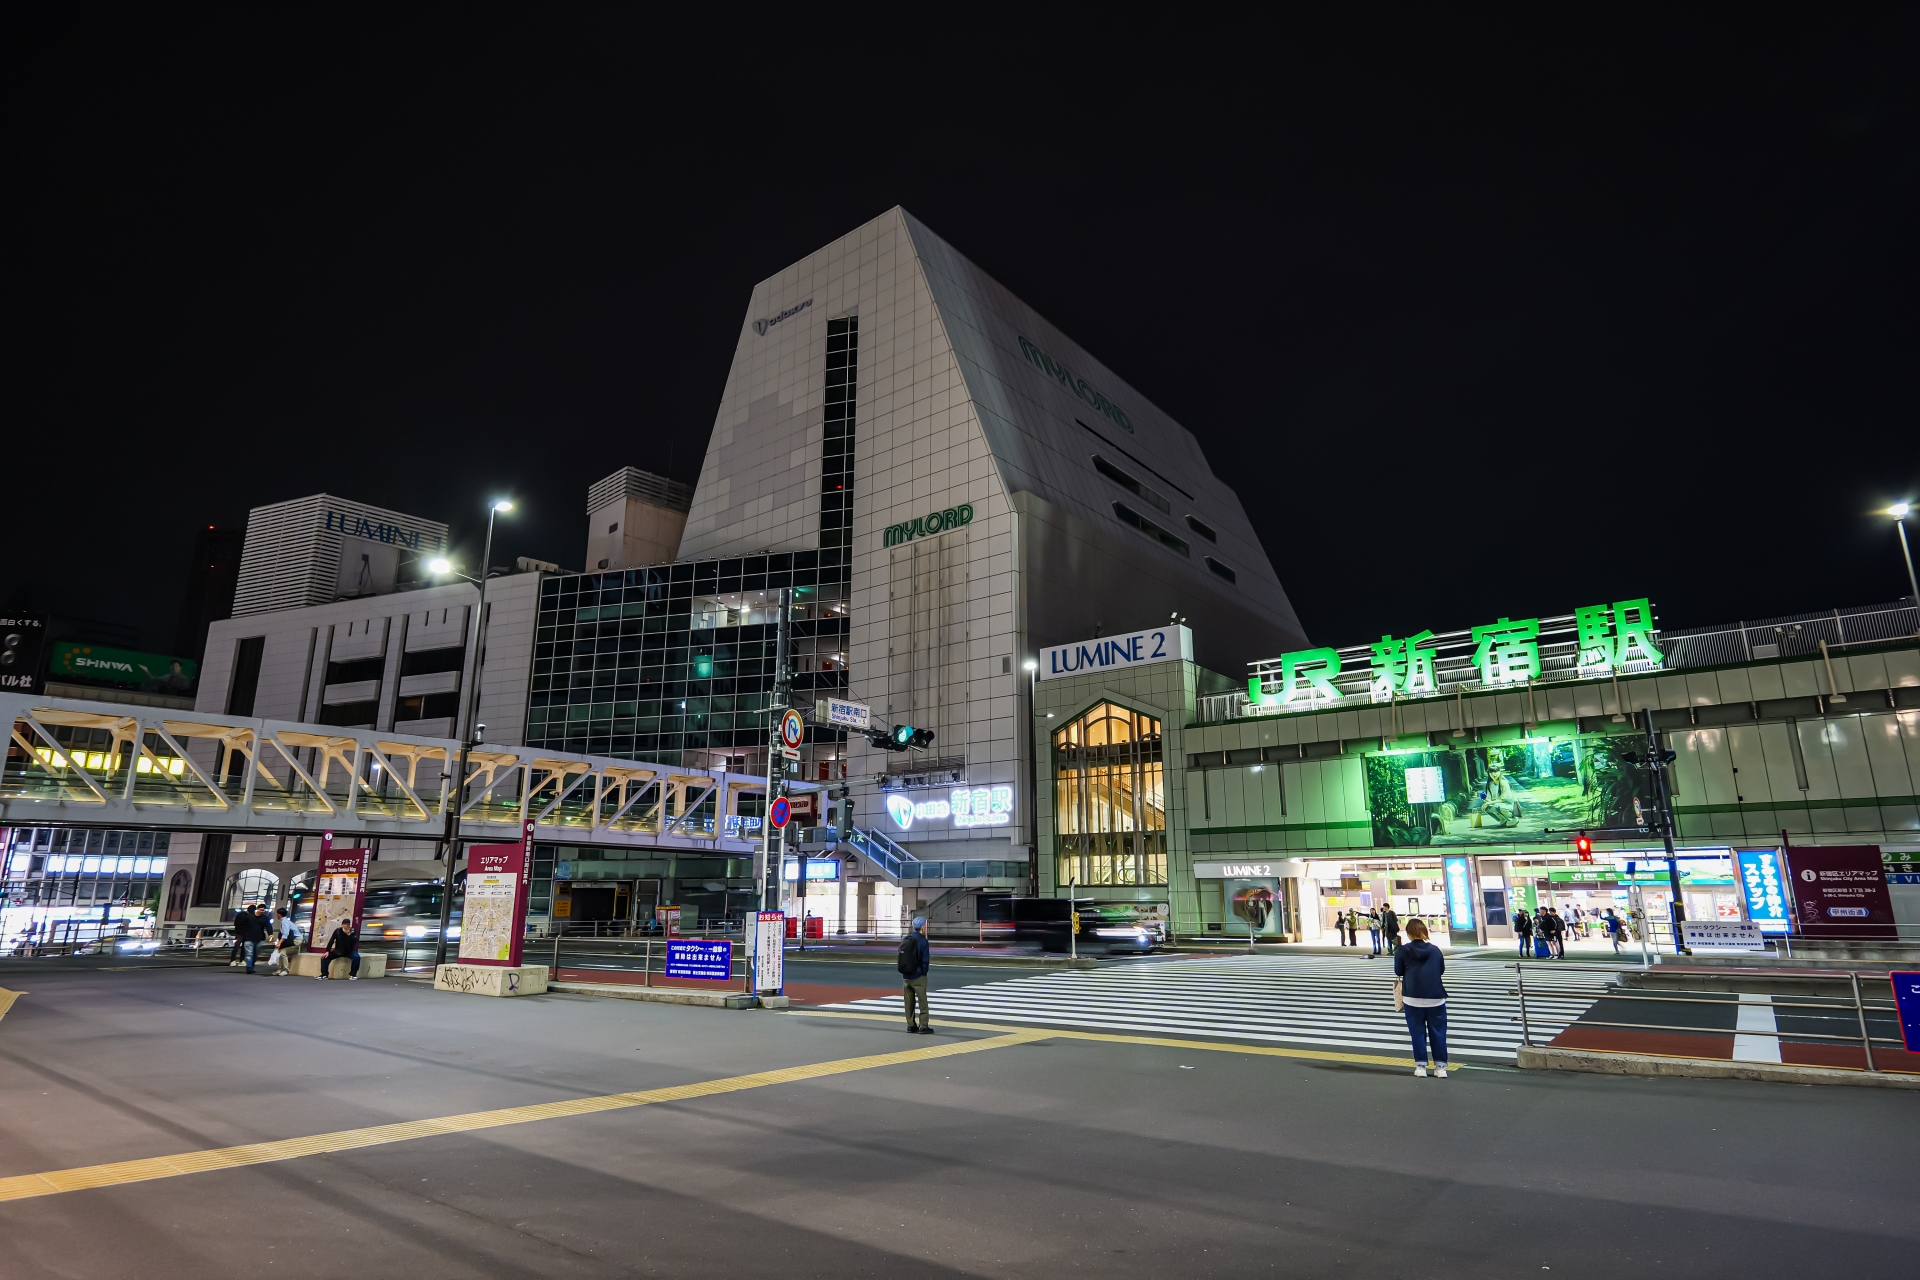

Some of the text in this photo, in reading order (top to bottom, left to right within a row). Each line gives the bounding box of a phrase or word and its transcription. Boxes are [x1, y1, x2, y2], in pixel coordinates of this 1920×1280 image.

[1017, 335, 1135, 435] MYLORD
[883, 504, 974, 548] MYLORD
[1051, 632, 1167, 674] LUMINE 2
[830, 703, 867, 718] 新宿駅南口
[831, 713, 849, 722] Shinjuku
[951, 789, 1009, 814] 新宿駅
[480, 856, 509, 865] エリアマップ
[1223, 864, 1272, 877] LUMINE 2
[758, 913, 783, 921] お知らせ
[1832, 908, 1864, 916] 甲州街道
